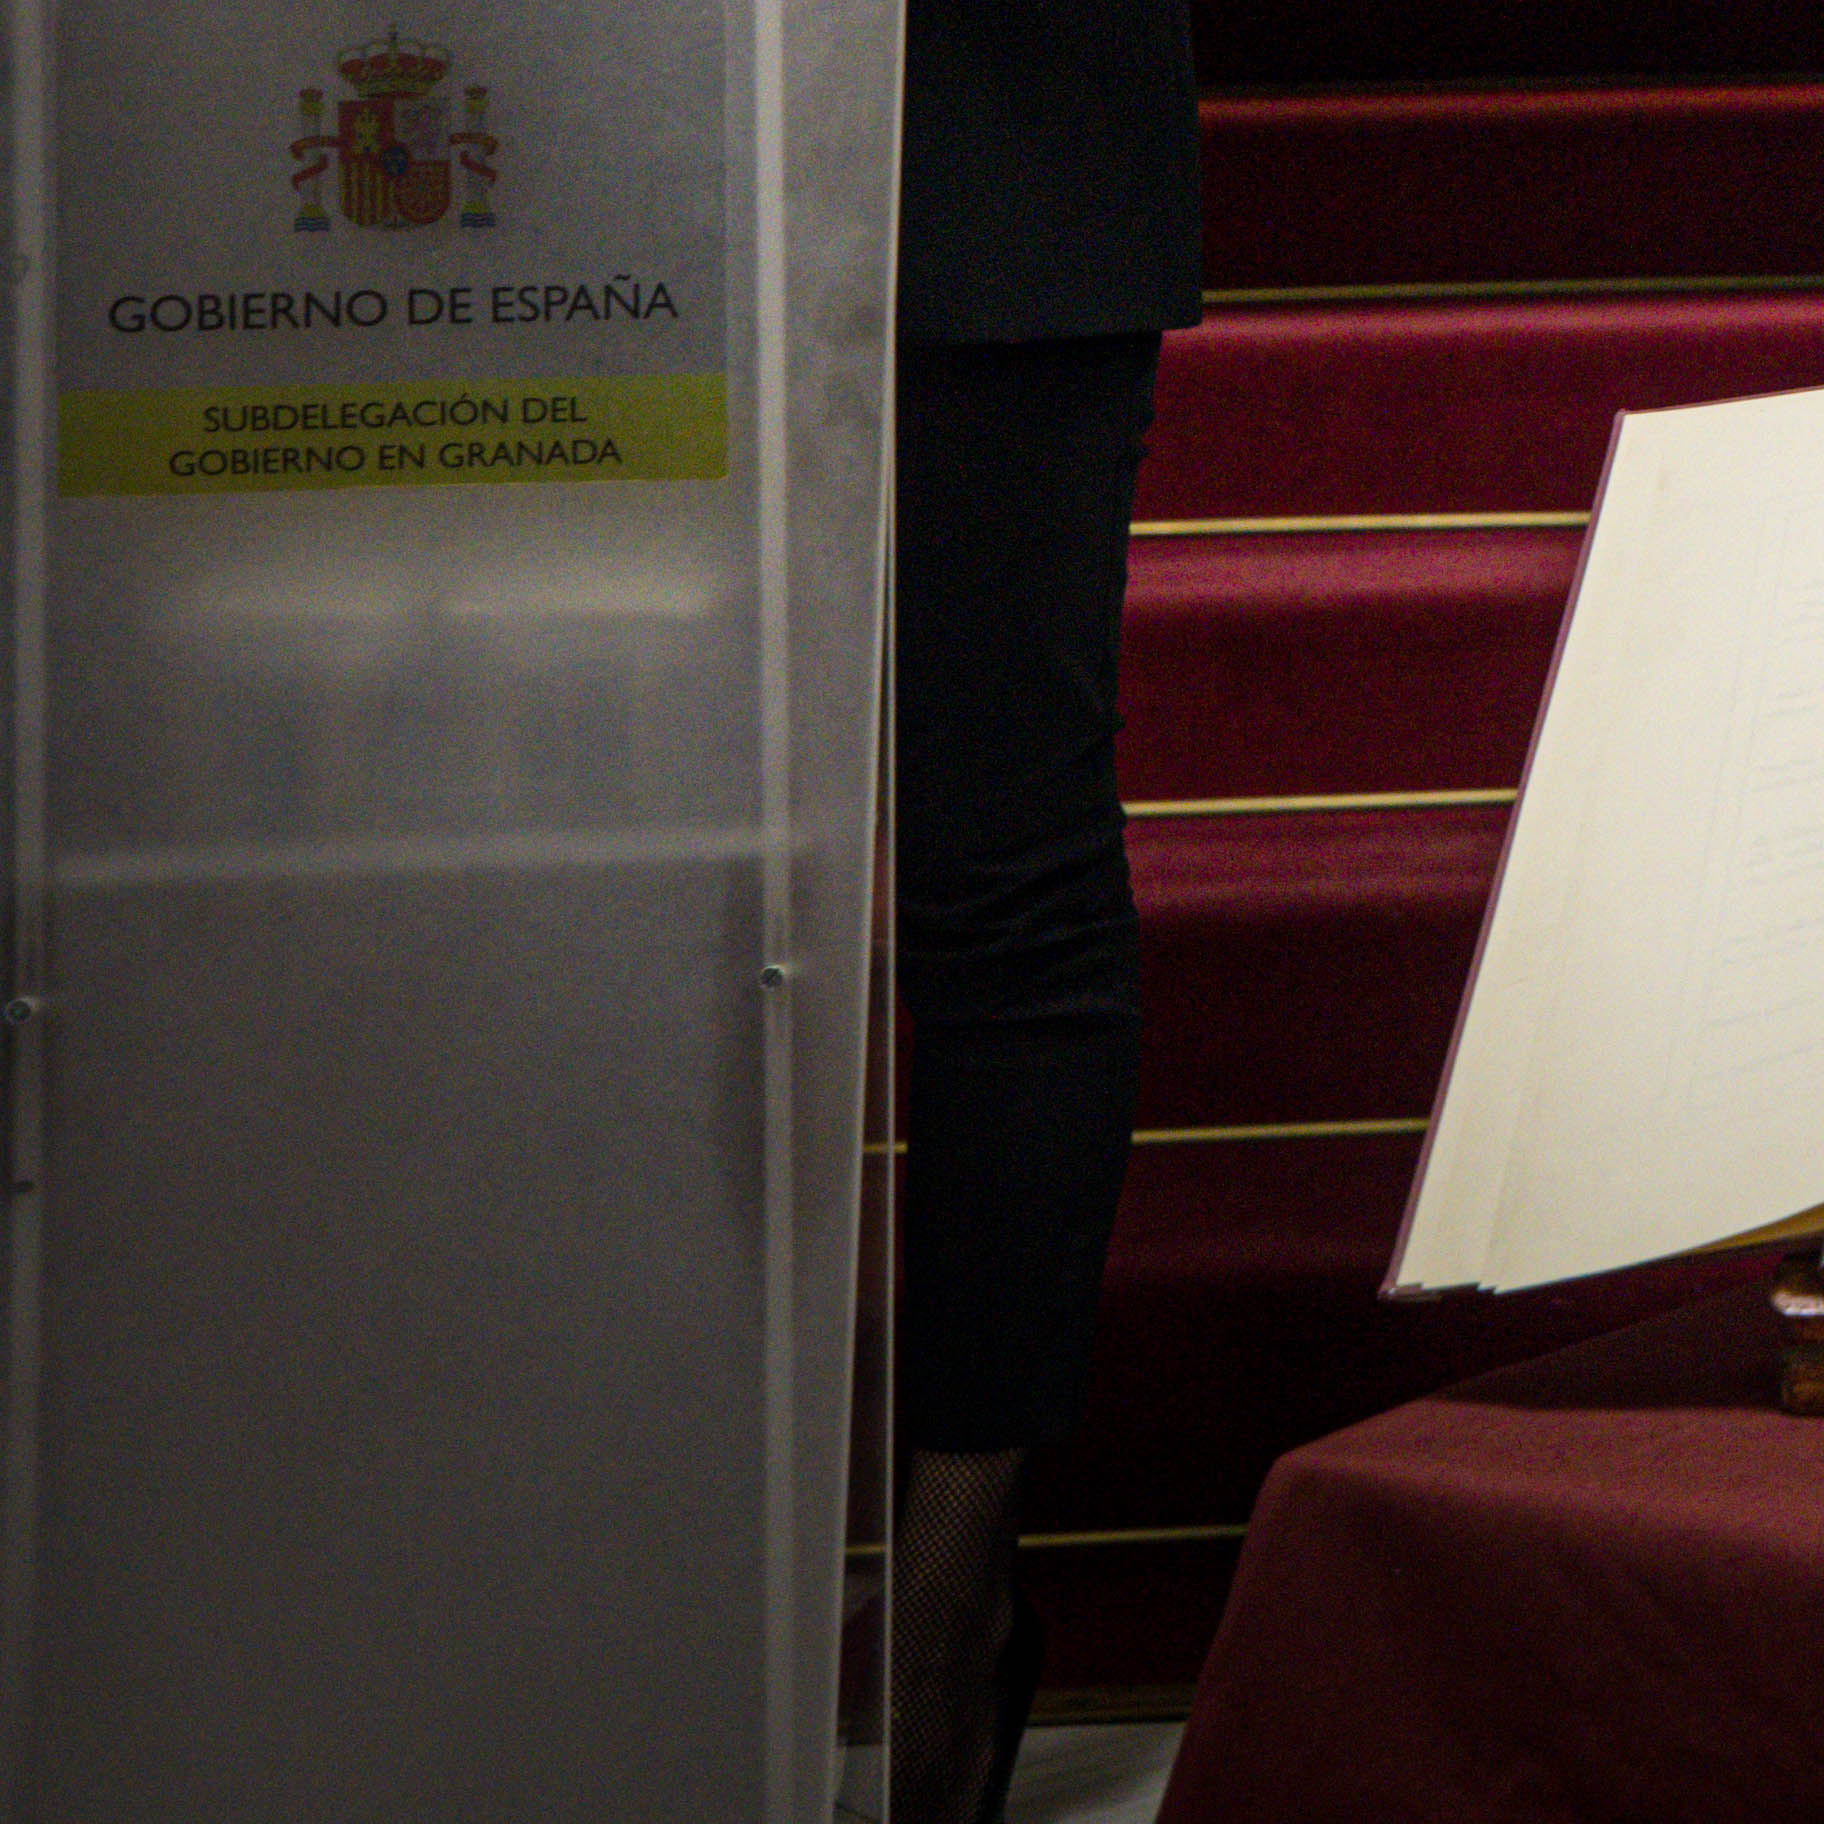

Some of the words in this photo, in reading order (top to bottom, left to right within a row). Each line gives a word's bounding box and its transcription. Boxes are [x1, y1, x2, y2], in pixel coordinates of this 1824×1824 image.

[107, 290, 388, 334] GOBIERNO
[408, 288, 471, 326] DE
[490, 274, 681, 323] ESPAÑA
[202, 394, 510, 434] SUBDELEGACIÓN
[522, 396, 587, 426] DEL
[169, 445, 366, 479] GOBIERNO
[378, 443, 425, 472] EN
[440, 437, 623, 470] GRANADA
